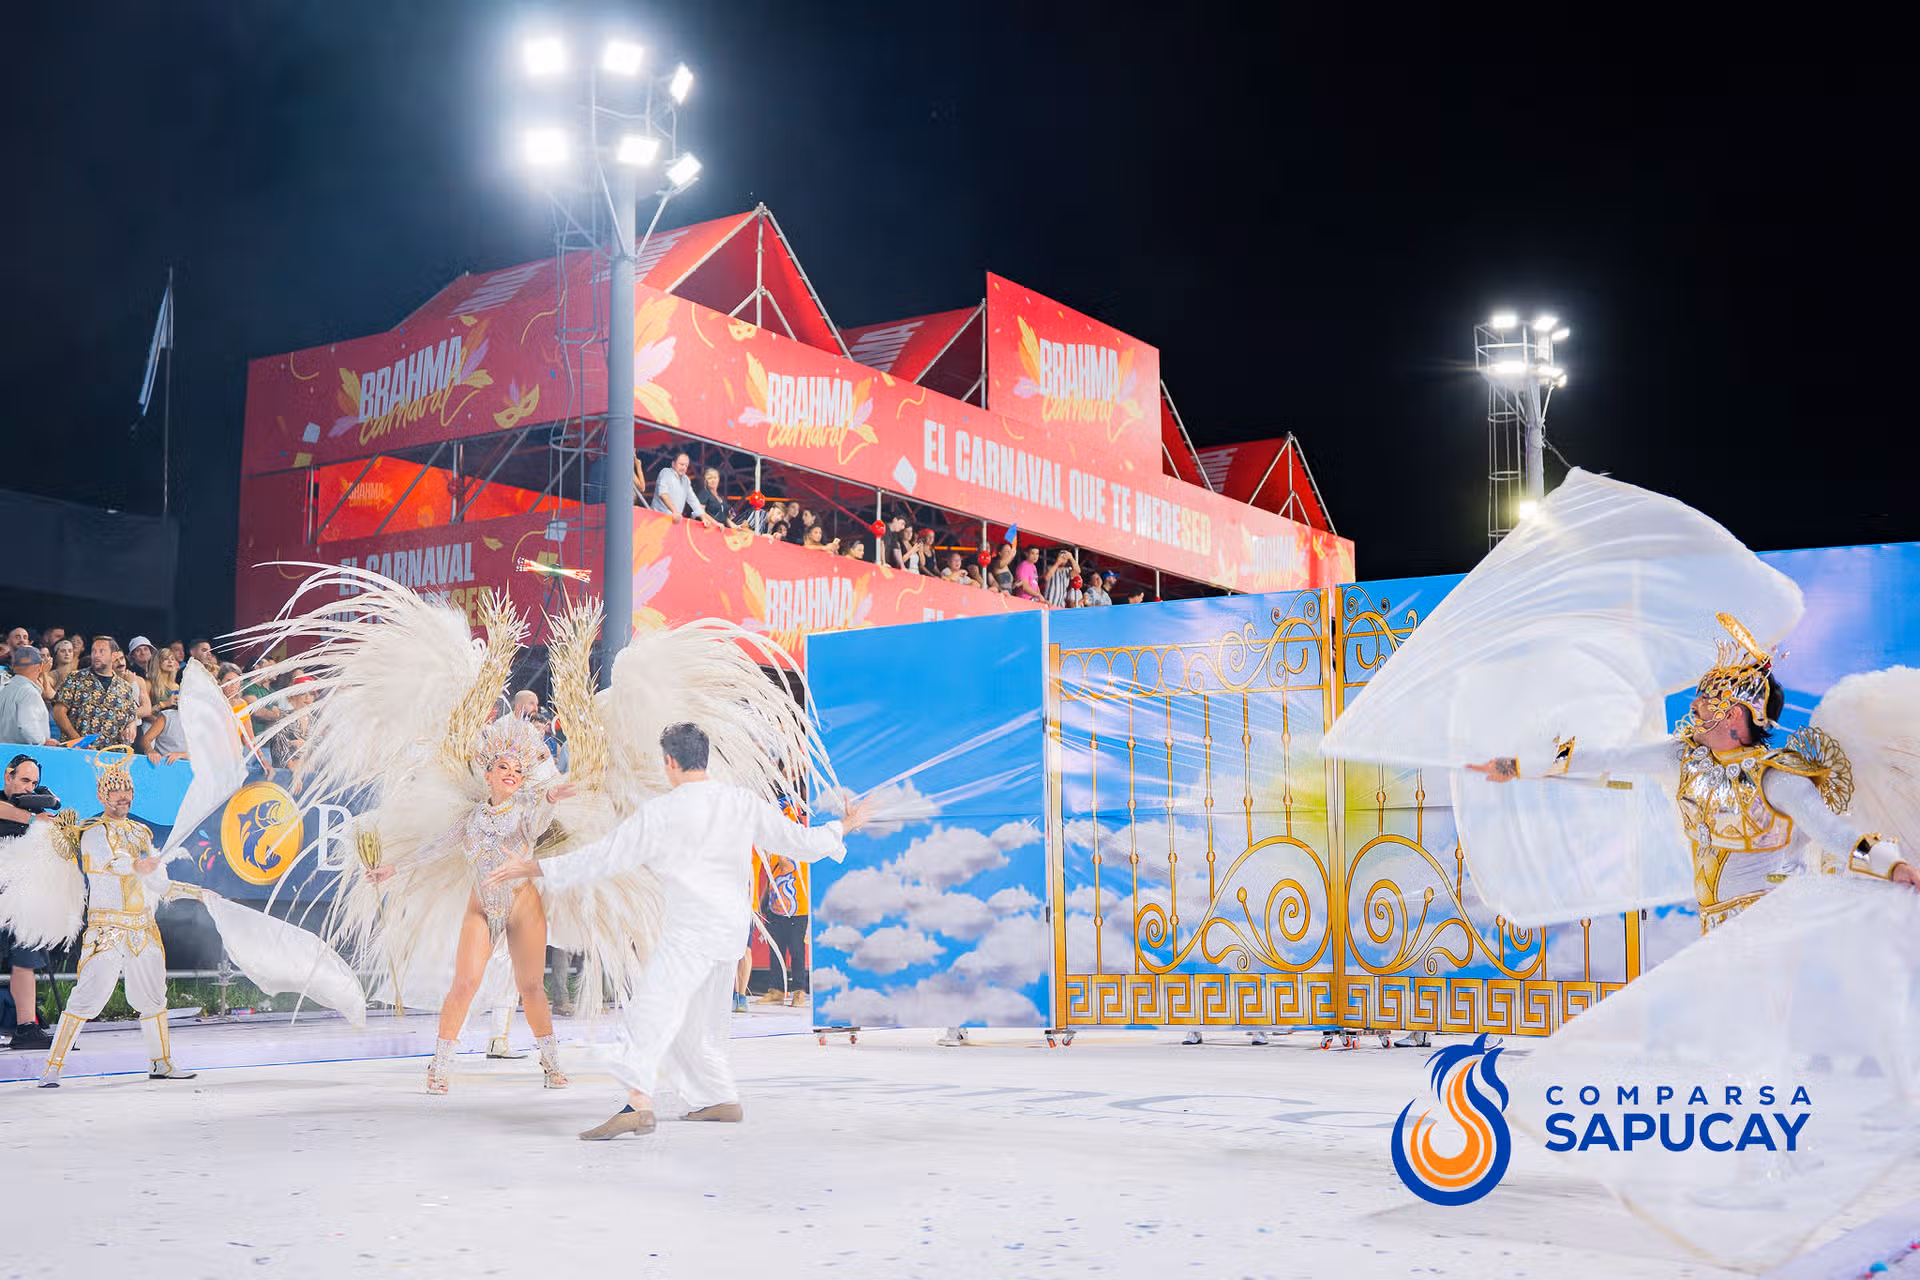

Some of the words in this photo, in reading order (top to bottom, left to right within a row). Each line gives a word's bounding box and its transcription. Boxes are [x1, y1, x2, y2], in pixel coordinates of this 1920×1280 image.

[358, 336, 463, 424] BRAHMA
[766, 371, 855, 430] BRAHMA
[1040, 337, 1120, 405] BRAHMA
[924, 419, 950, 476] EL
[955, 430, 1064, 511] CARNAVAL
[1069, 468, 1106, 523] QUE
[1110, 481, 1132, 533] TE
[1135, 490, 1212, 556] MERESED
[365, 542, 475, 593] CARNAVAL
[764, 576, 855, 633] BRAHMA
